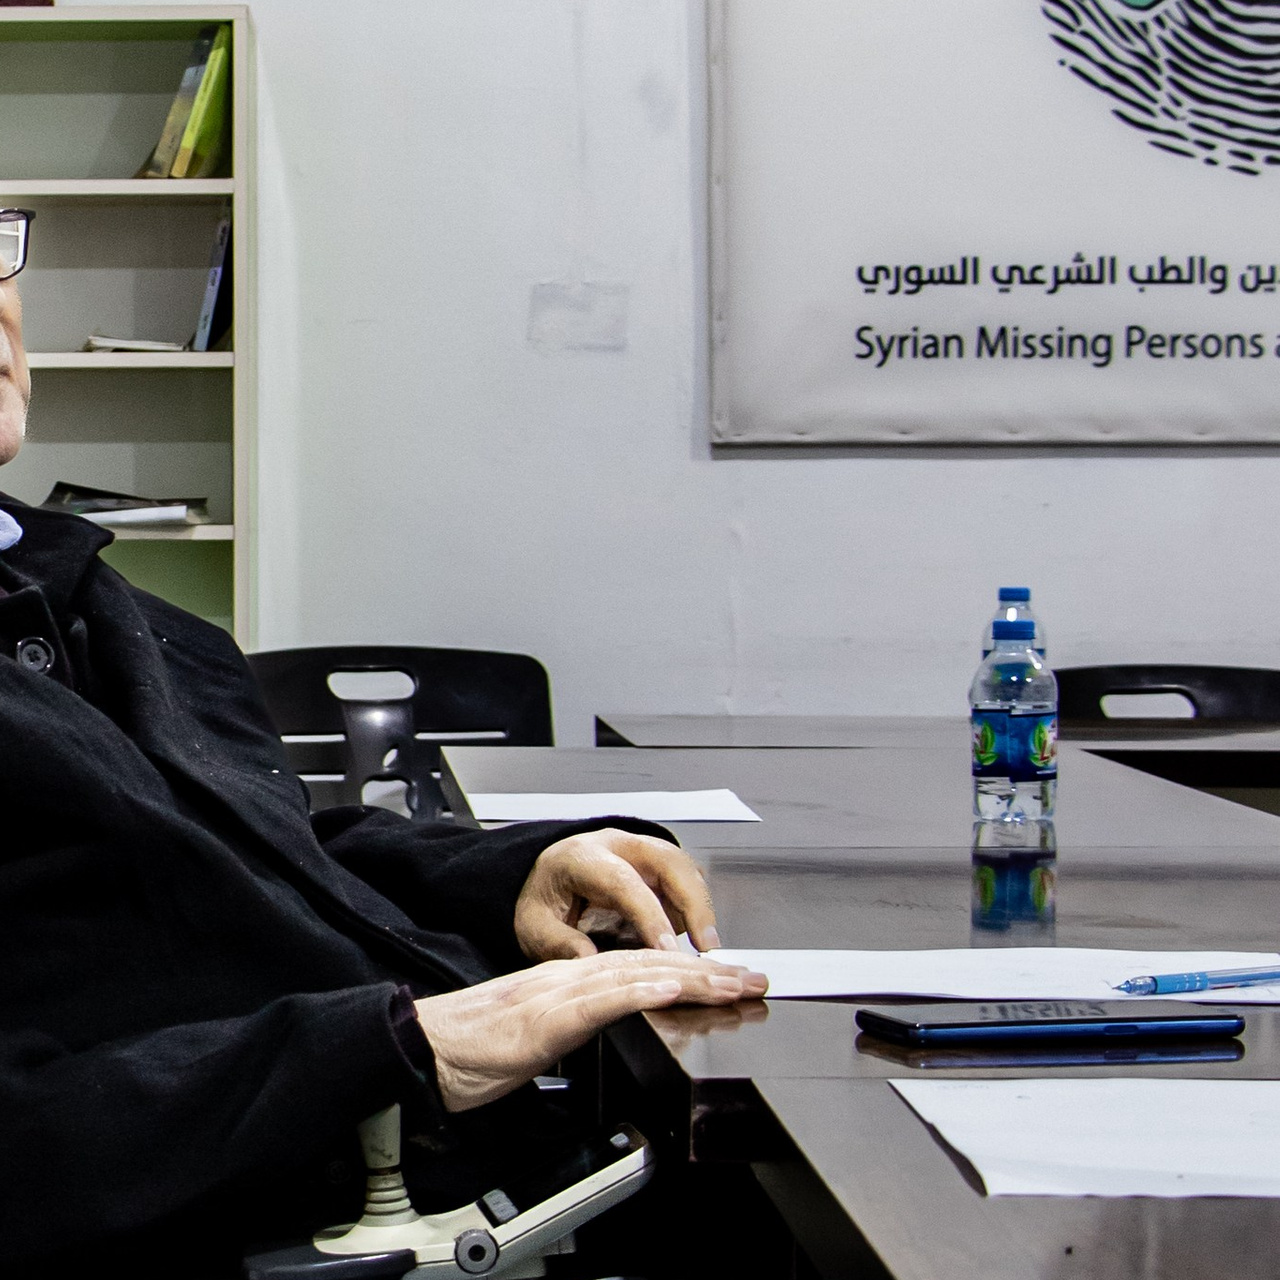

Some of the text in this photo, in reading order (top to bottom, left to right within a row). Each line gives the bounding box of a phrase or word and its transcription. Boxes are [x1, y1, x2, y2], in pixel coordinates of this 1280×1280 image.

[856, 255, 980, 296] السوري
[990, 252, 1117, 295] الشرعي
[1128, 255, 1228, 295] والطب
[854, 325, 965, 368] Syrian
[976, 325, 1113, 368] Missing
[1125, 325, 1265, 359] Persons
